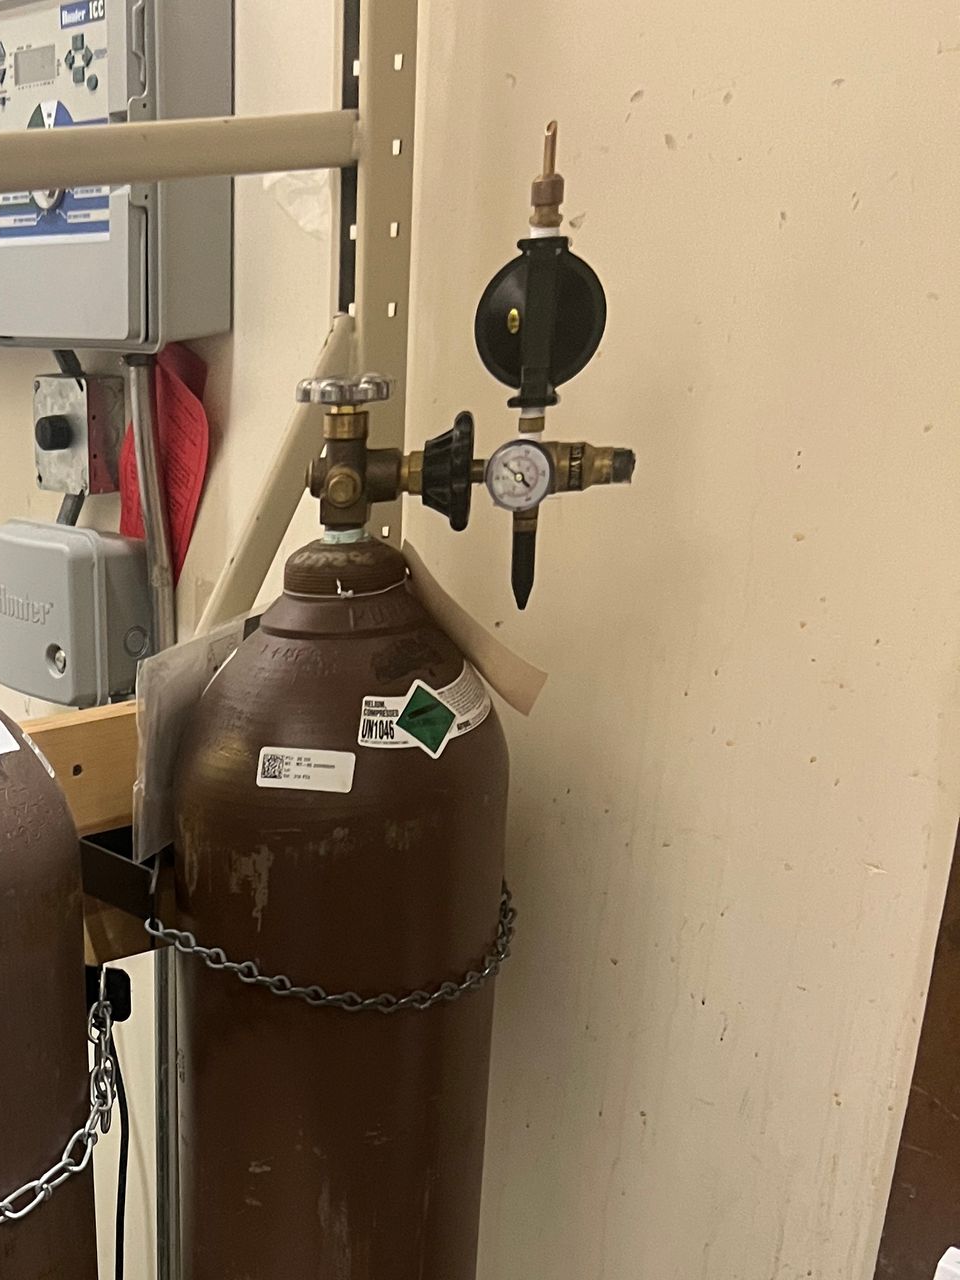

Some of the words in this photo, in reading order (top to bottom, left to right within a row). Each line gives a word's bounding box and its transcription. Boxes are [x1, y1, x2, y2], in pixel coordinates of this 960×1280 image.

[89, 0, 104, 20] ICC
[363, 708, 399, 718] COMPRESSED
[361, 718, 395, 740] UN1046
